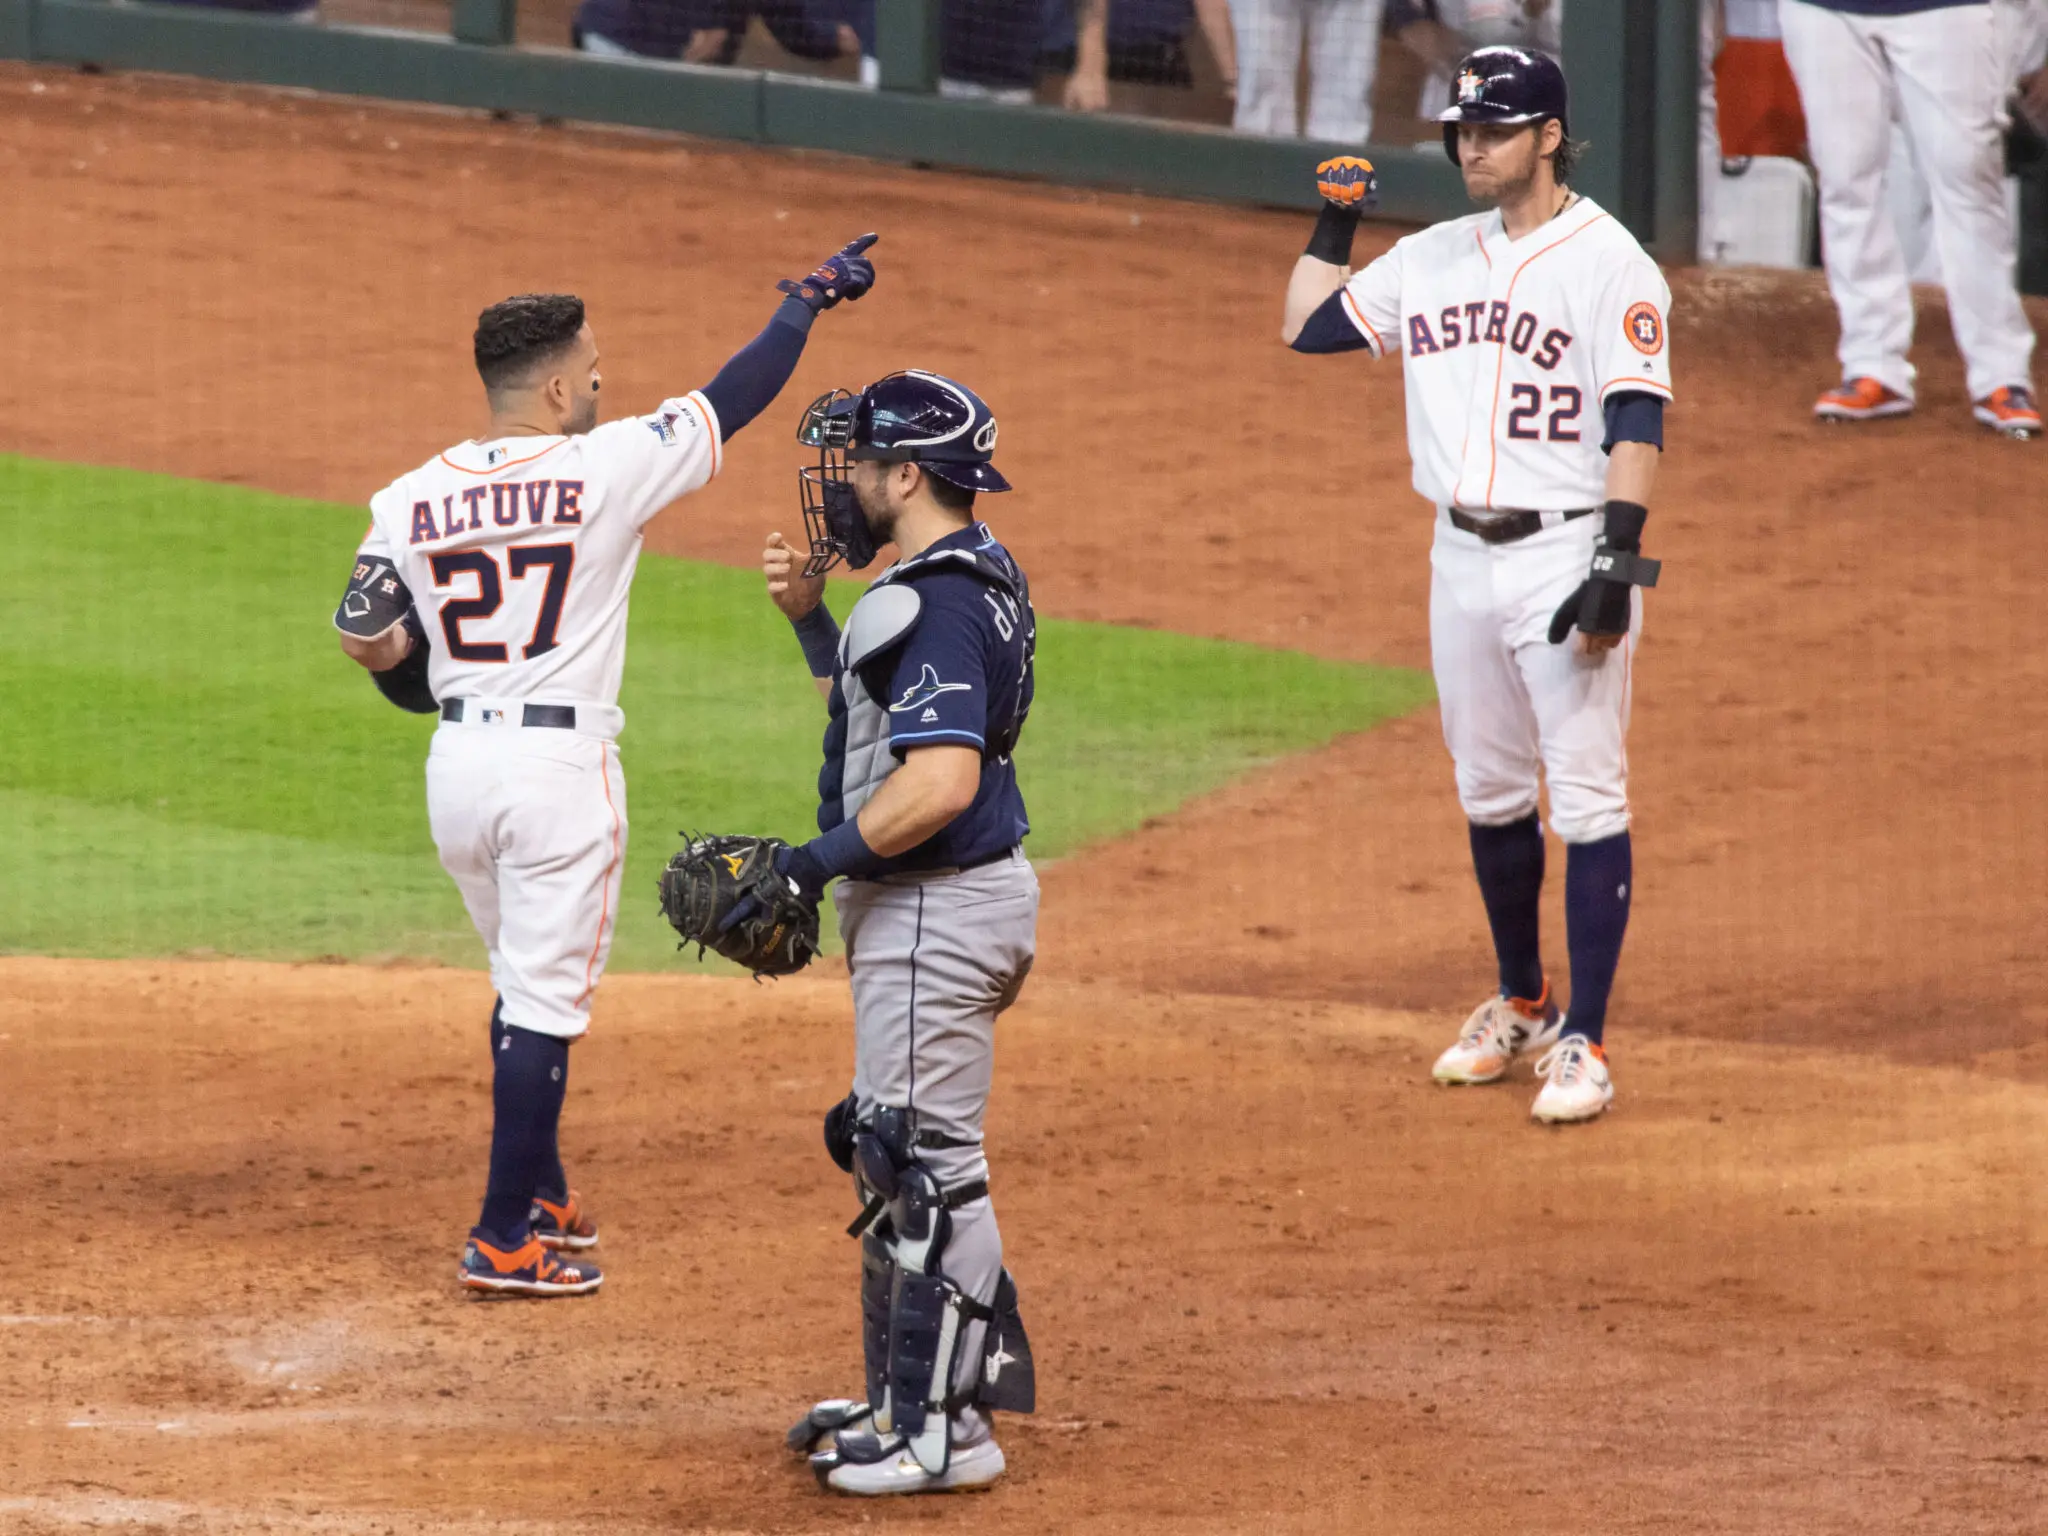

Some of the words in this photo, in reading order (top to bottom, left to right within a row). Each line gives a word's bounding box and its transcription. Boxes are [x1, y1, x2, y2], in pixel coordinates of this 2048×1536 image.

[1408, 300, 1574, 370] ASTROS
[1508, 383, 1582, 442] 22
[409, 480, 584, 544] ALTUVE
[353, 563, 371, 581] 27
[428, 542, 575, 663] 27
